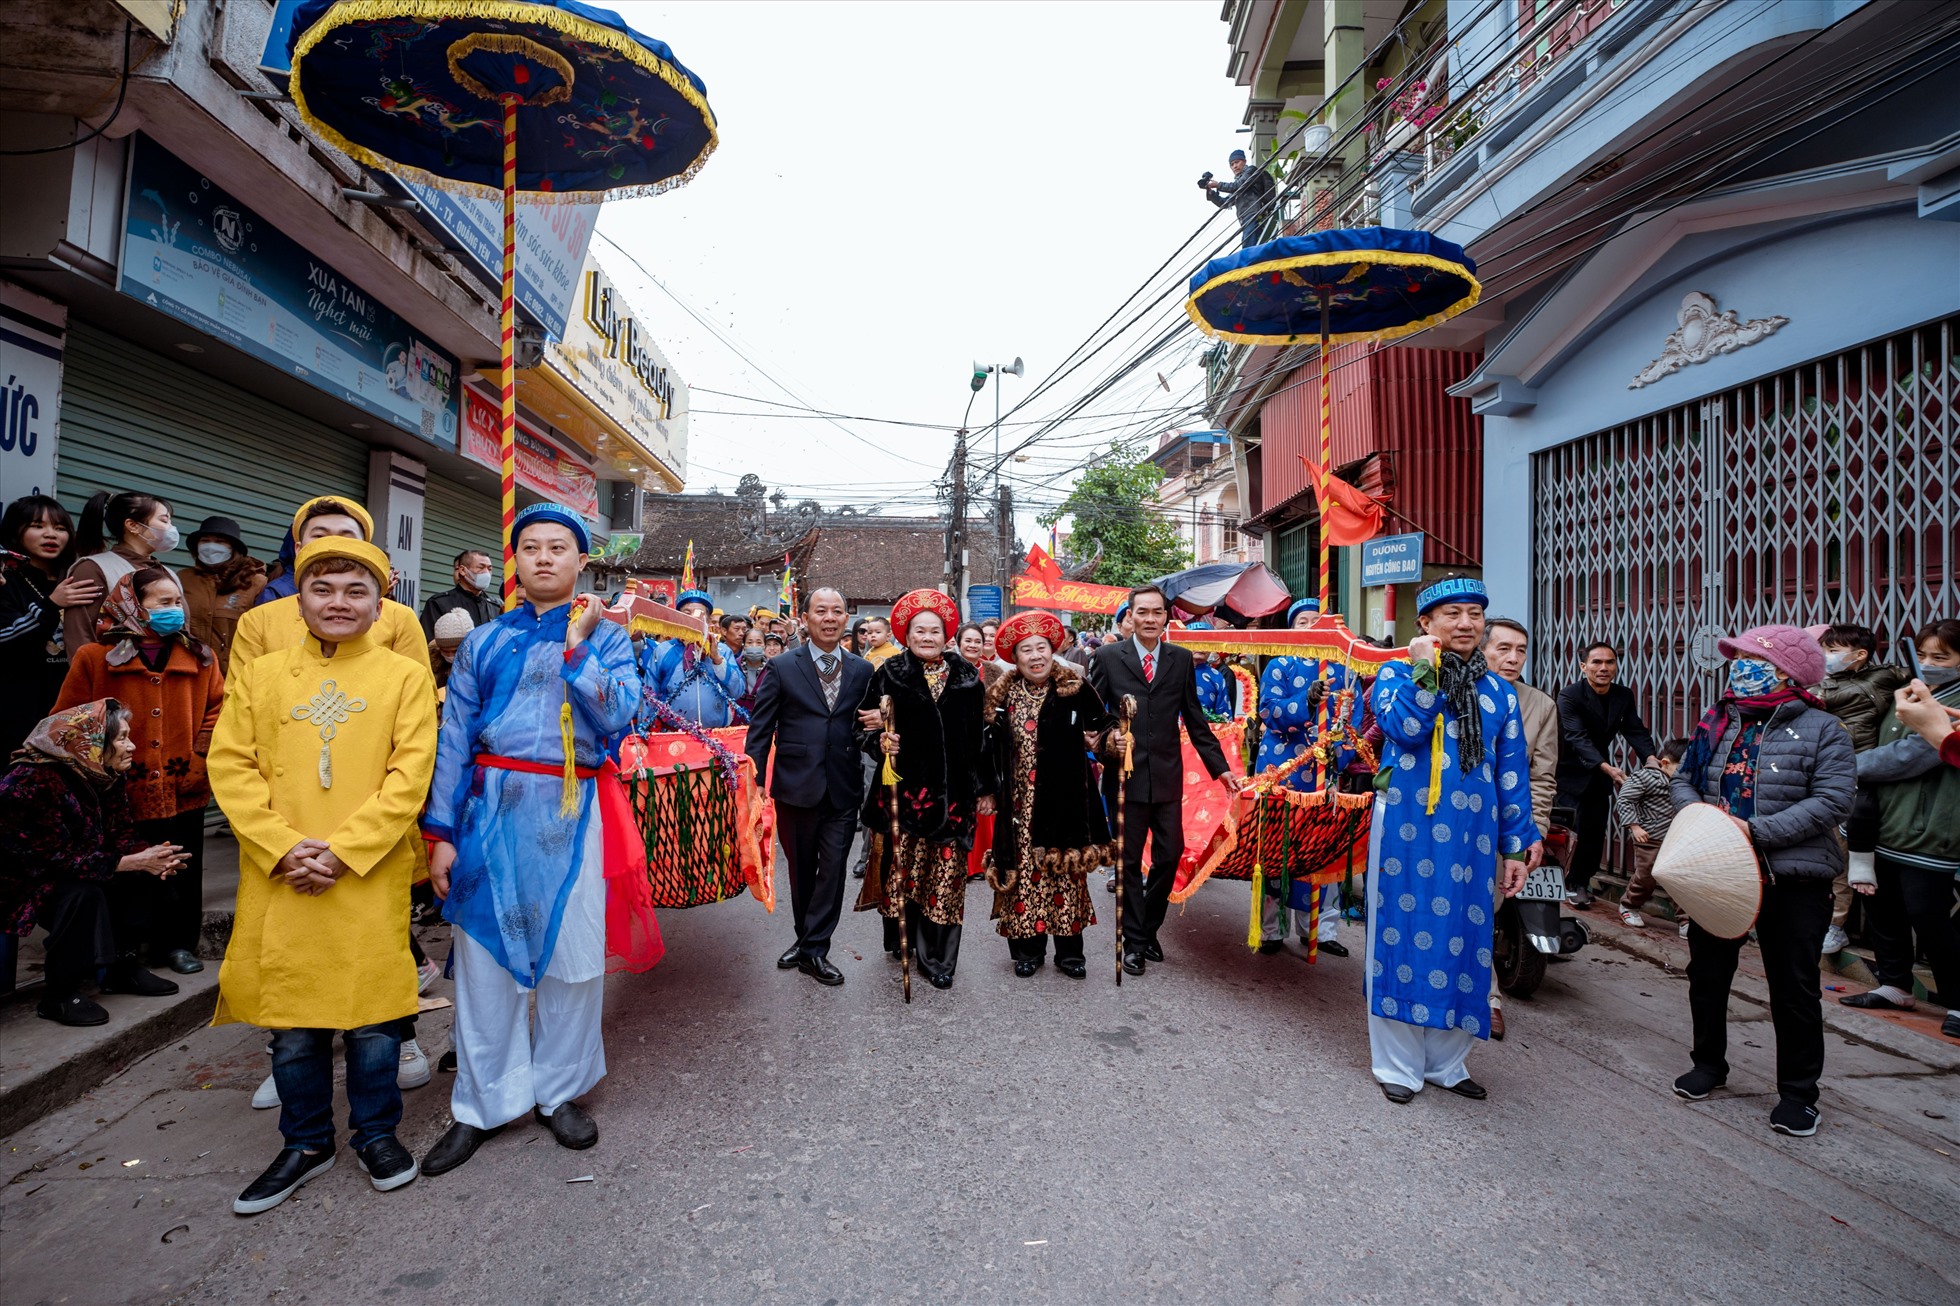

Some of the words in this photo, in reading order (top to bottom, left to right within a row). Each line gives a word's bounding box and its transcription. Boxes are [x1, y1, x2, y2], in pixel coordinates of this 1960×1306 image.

[456, 220, 479, 250] QUẢNG
[477, 241, 491, 262] YÊN
[526, 234, 541, 257] sóc
[538, 250, 554, 272] sức
[567, 211, 588, 262] 36
[191, 245, 222, 263] COMBO
[223, 256, 253, 284] NEBUSAL
[192, 259, 210, 273] BẢO
[211, 268, 221, 280] VỆ
[222, 273, 235, 286] GIA
[236, 282, 253, 300] ĐÌNH
[253, 293, 267, 308] BẠN
[307, 261, 338, 299] XUA
[341, 285, 366, 316] TAN
[349, 320, 373, 342] mũi
[586, 271, 623, 360] Lily
[622, 317, 676, 420] Beauty
[0, 374, 40, 457] ỨC
[469, 431, 499, 459] EAUTY
[397, 514, 413, 551] AN
[1384, 559, 1401, 574] CÔNG
[1401, 558, 1416, 573] BAO
[1053, 584, 1107, 610] Mừng
